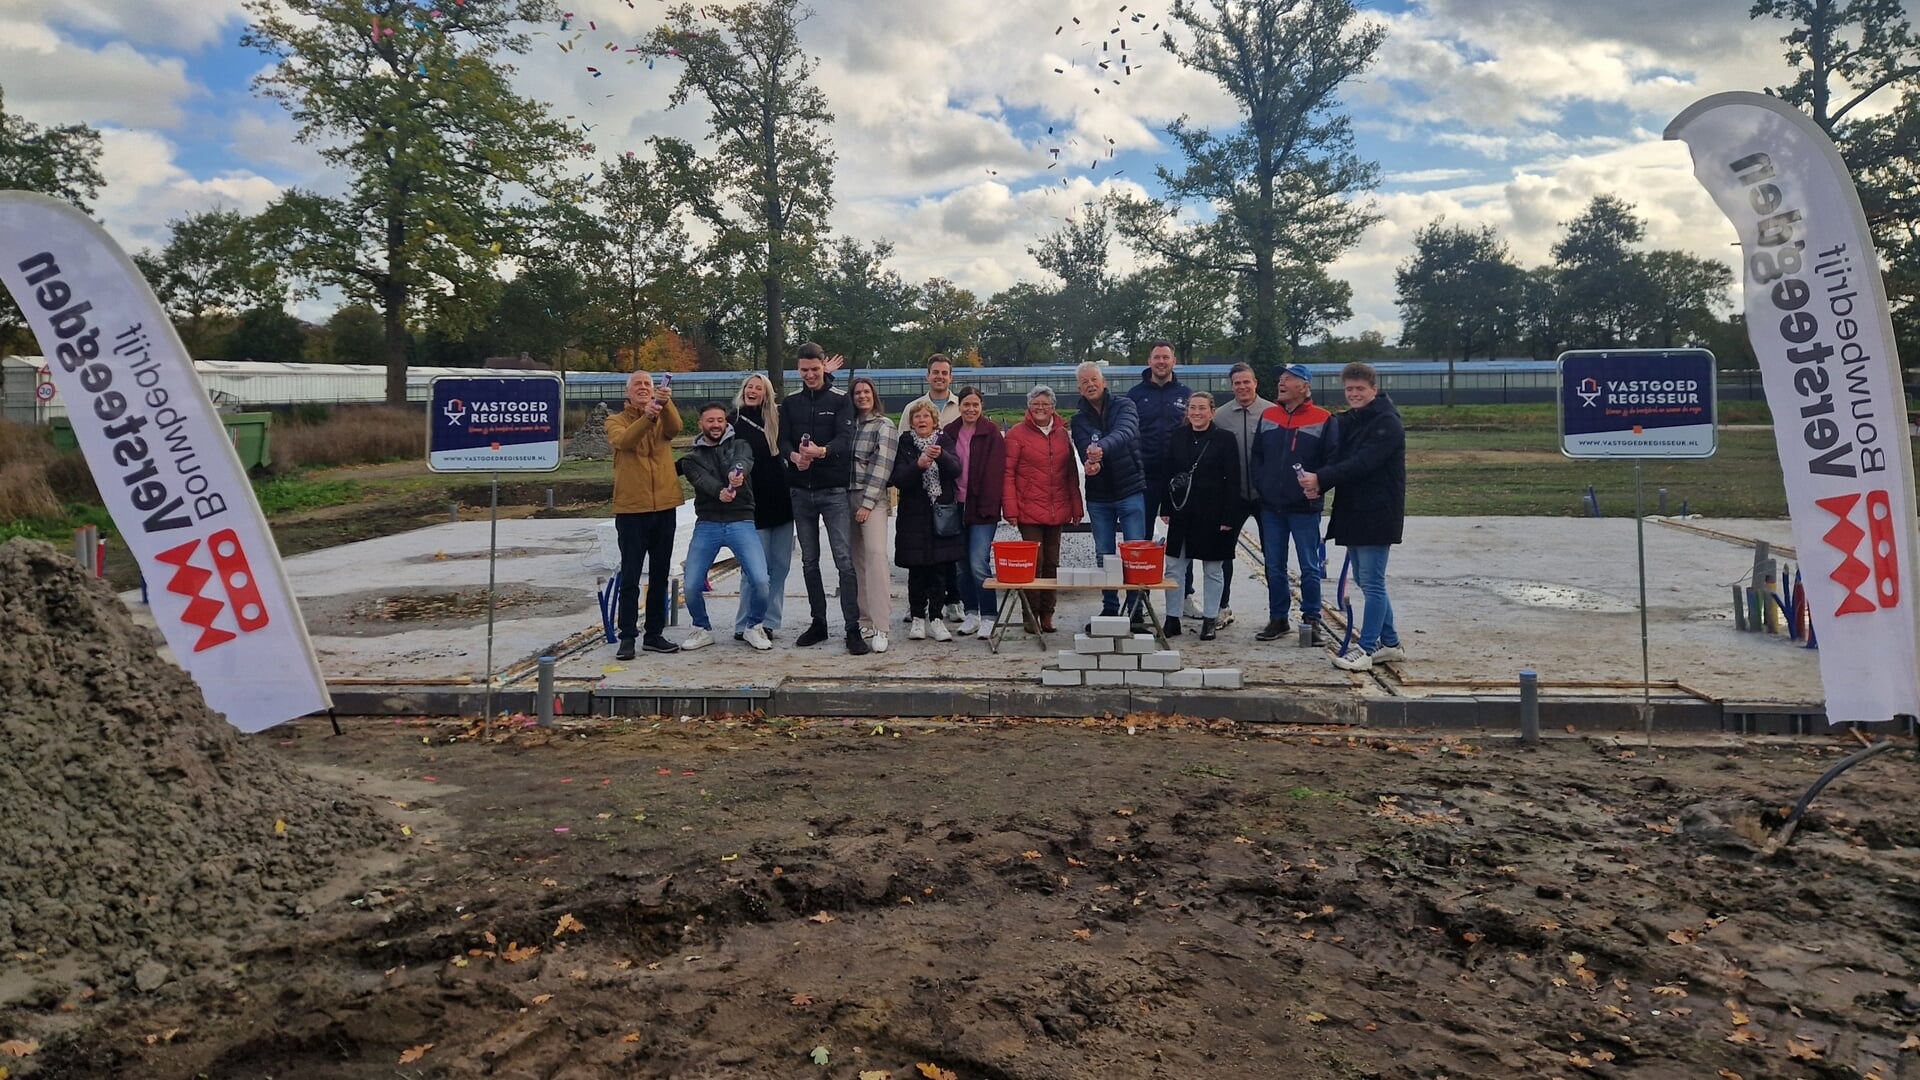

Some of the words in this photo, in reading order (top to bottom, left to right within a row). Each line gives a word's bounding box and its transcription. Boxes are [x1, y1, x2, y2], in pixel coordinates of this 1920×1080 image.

[39, 387, 51, 396] 30
[1607, 380, 1698, 392] VASTGOED
[1608, 393, 1699, 404] REGISSEUR
[471, 401, 548, 412] VASTGOED
[471, 413, 548, 423] REGISSEUR
